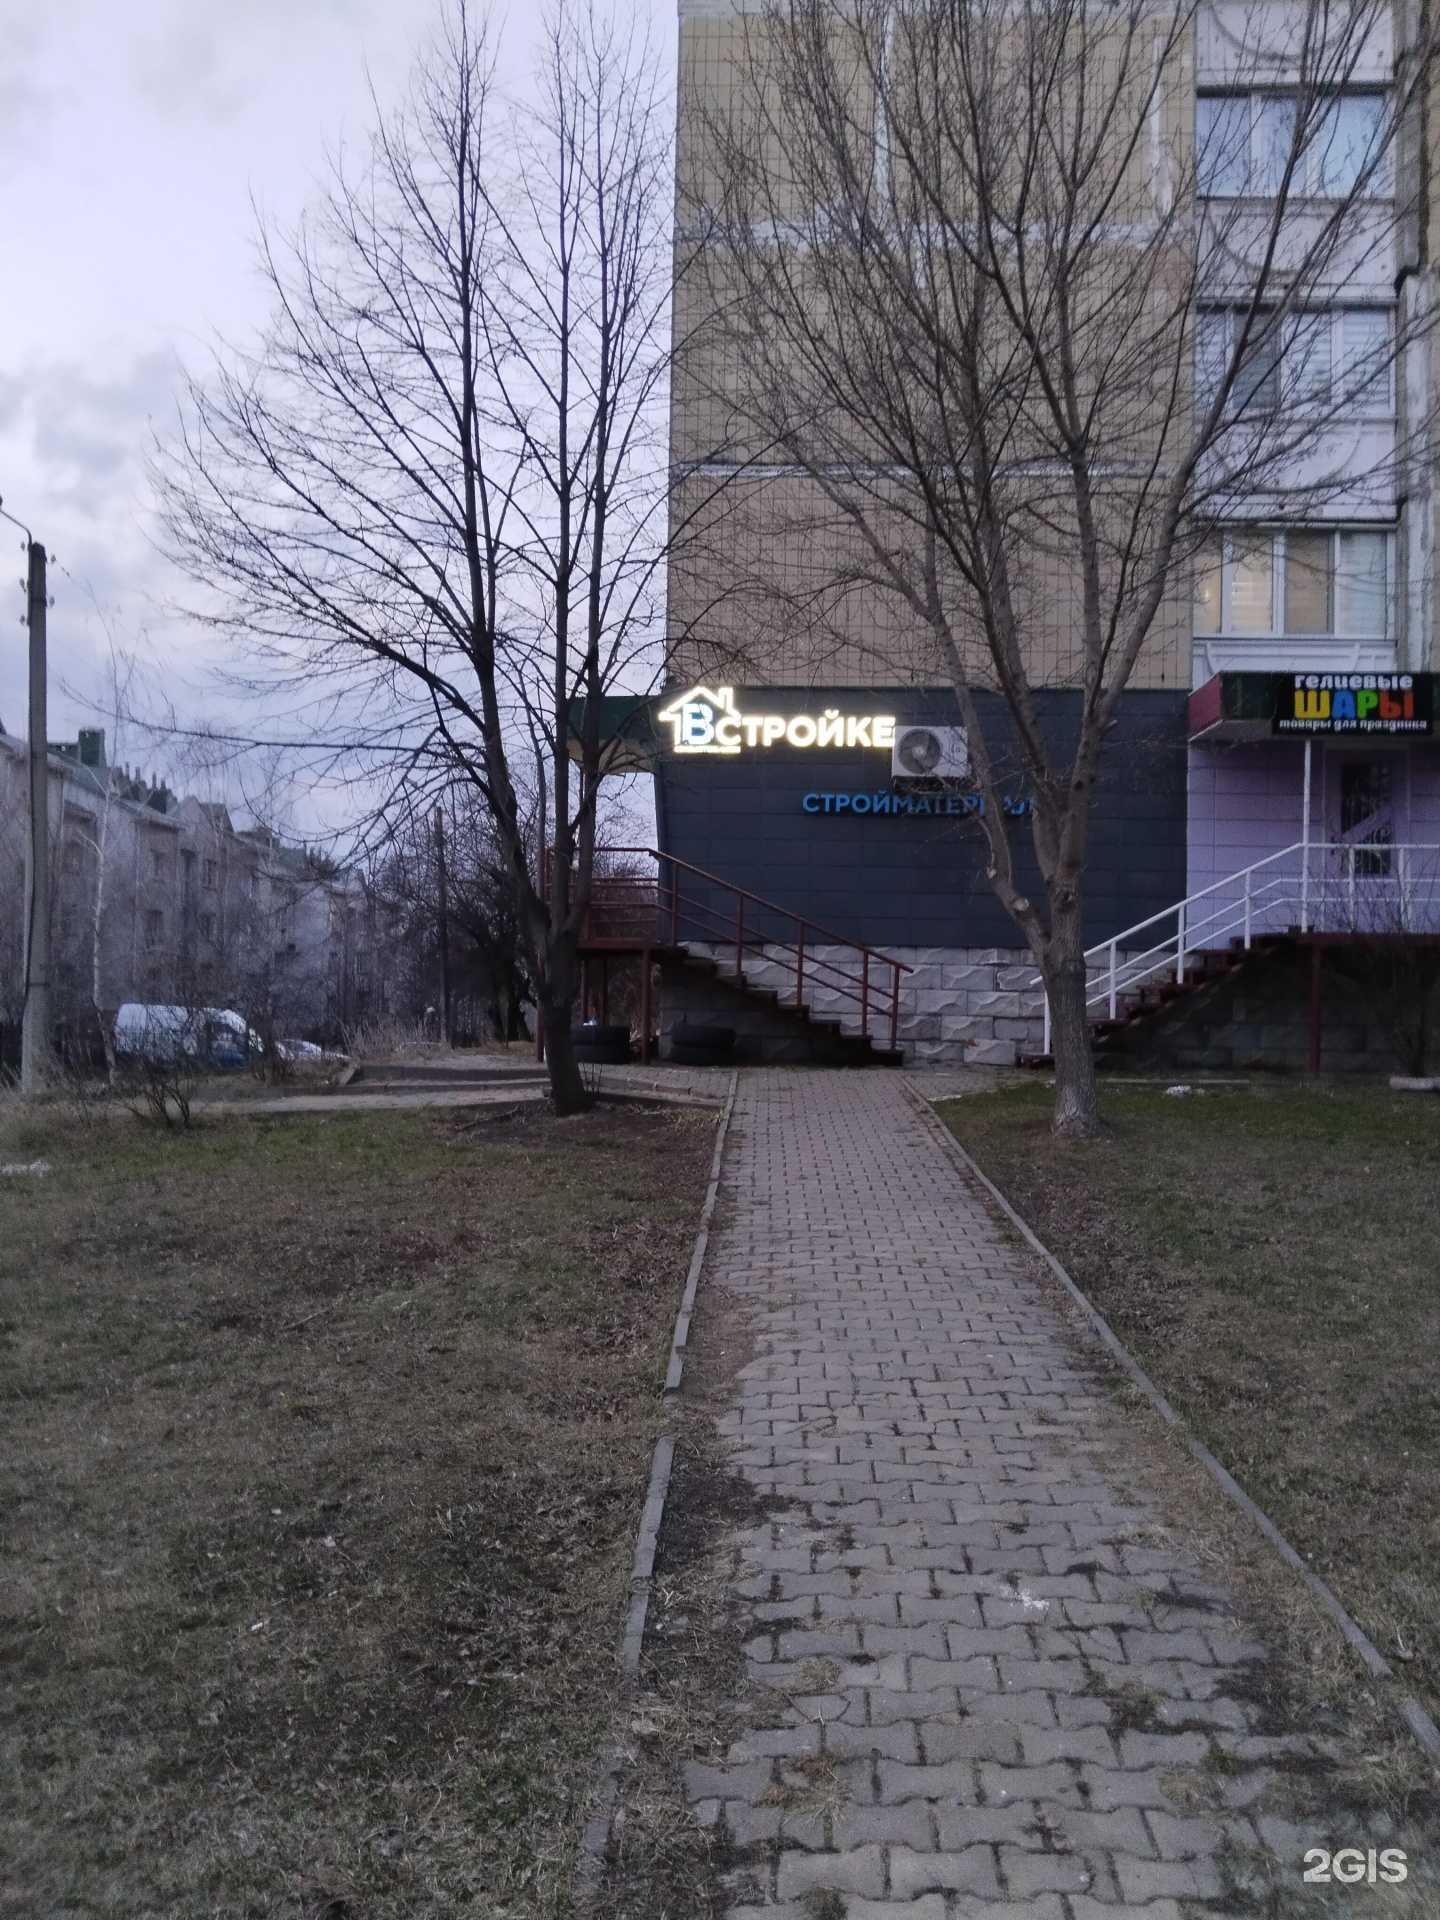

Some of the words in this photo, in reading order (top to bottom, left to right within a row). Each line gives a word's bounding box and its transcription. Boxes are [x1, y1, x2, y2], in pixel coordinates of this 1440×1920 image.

[1294, 689, 1414, 719] ШАРЫ
[1333, 719, 1357, 731] для
[802, 790, 1042, 817] СТРОЙМАТЕР
